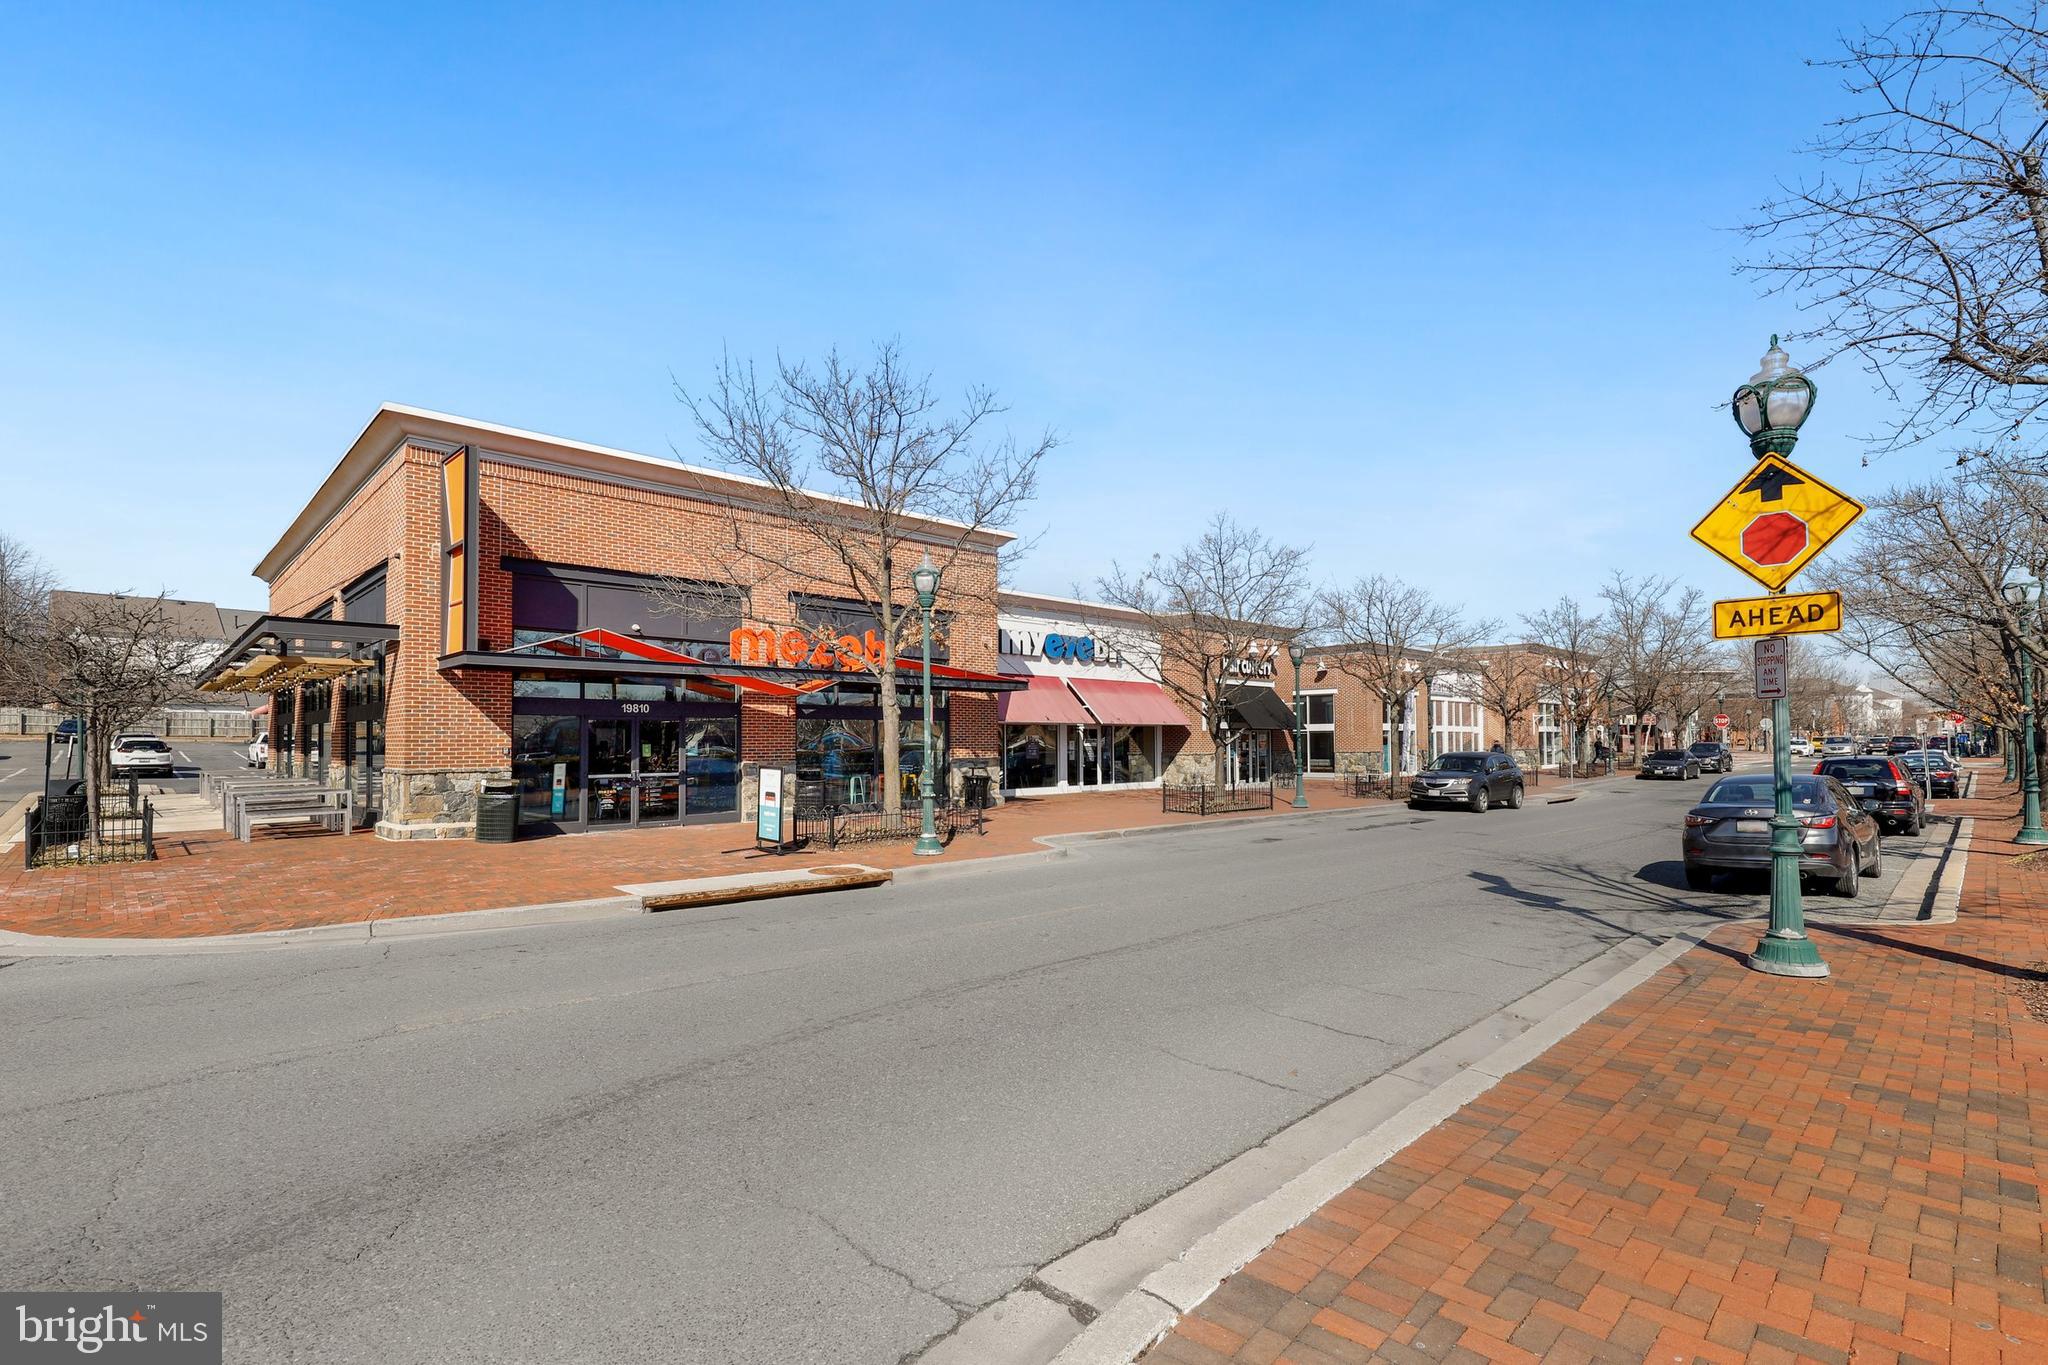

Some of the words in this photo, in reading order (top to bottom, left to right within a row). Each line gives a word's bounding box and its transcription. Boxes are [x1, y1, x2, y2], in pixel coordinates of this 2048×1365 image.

[1729, 603, 1825, 629] AHEAD
[1763, 643, 1776, 655] NO
[1757, 654, 1784, 667] STOPPING
[1763, 667, 1777, 677] ANY
[1762, 677, 1779, 686] TIME
[621, 703, 650, 714] 19810
[1714, 717, 1728, 725] STOP
